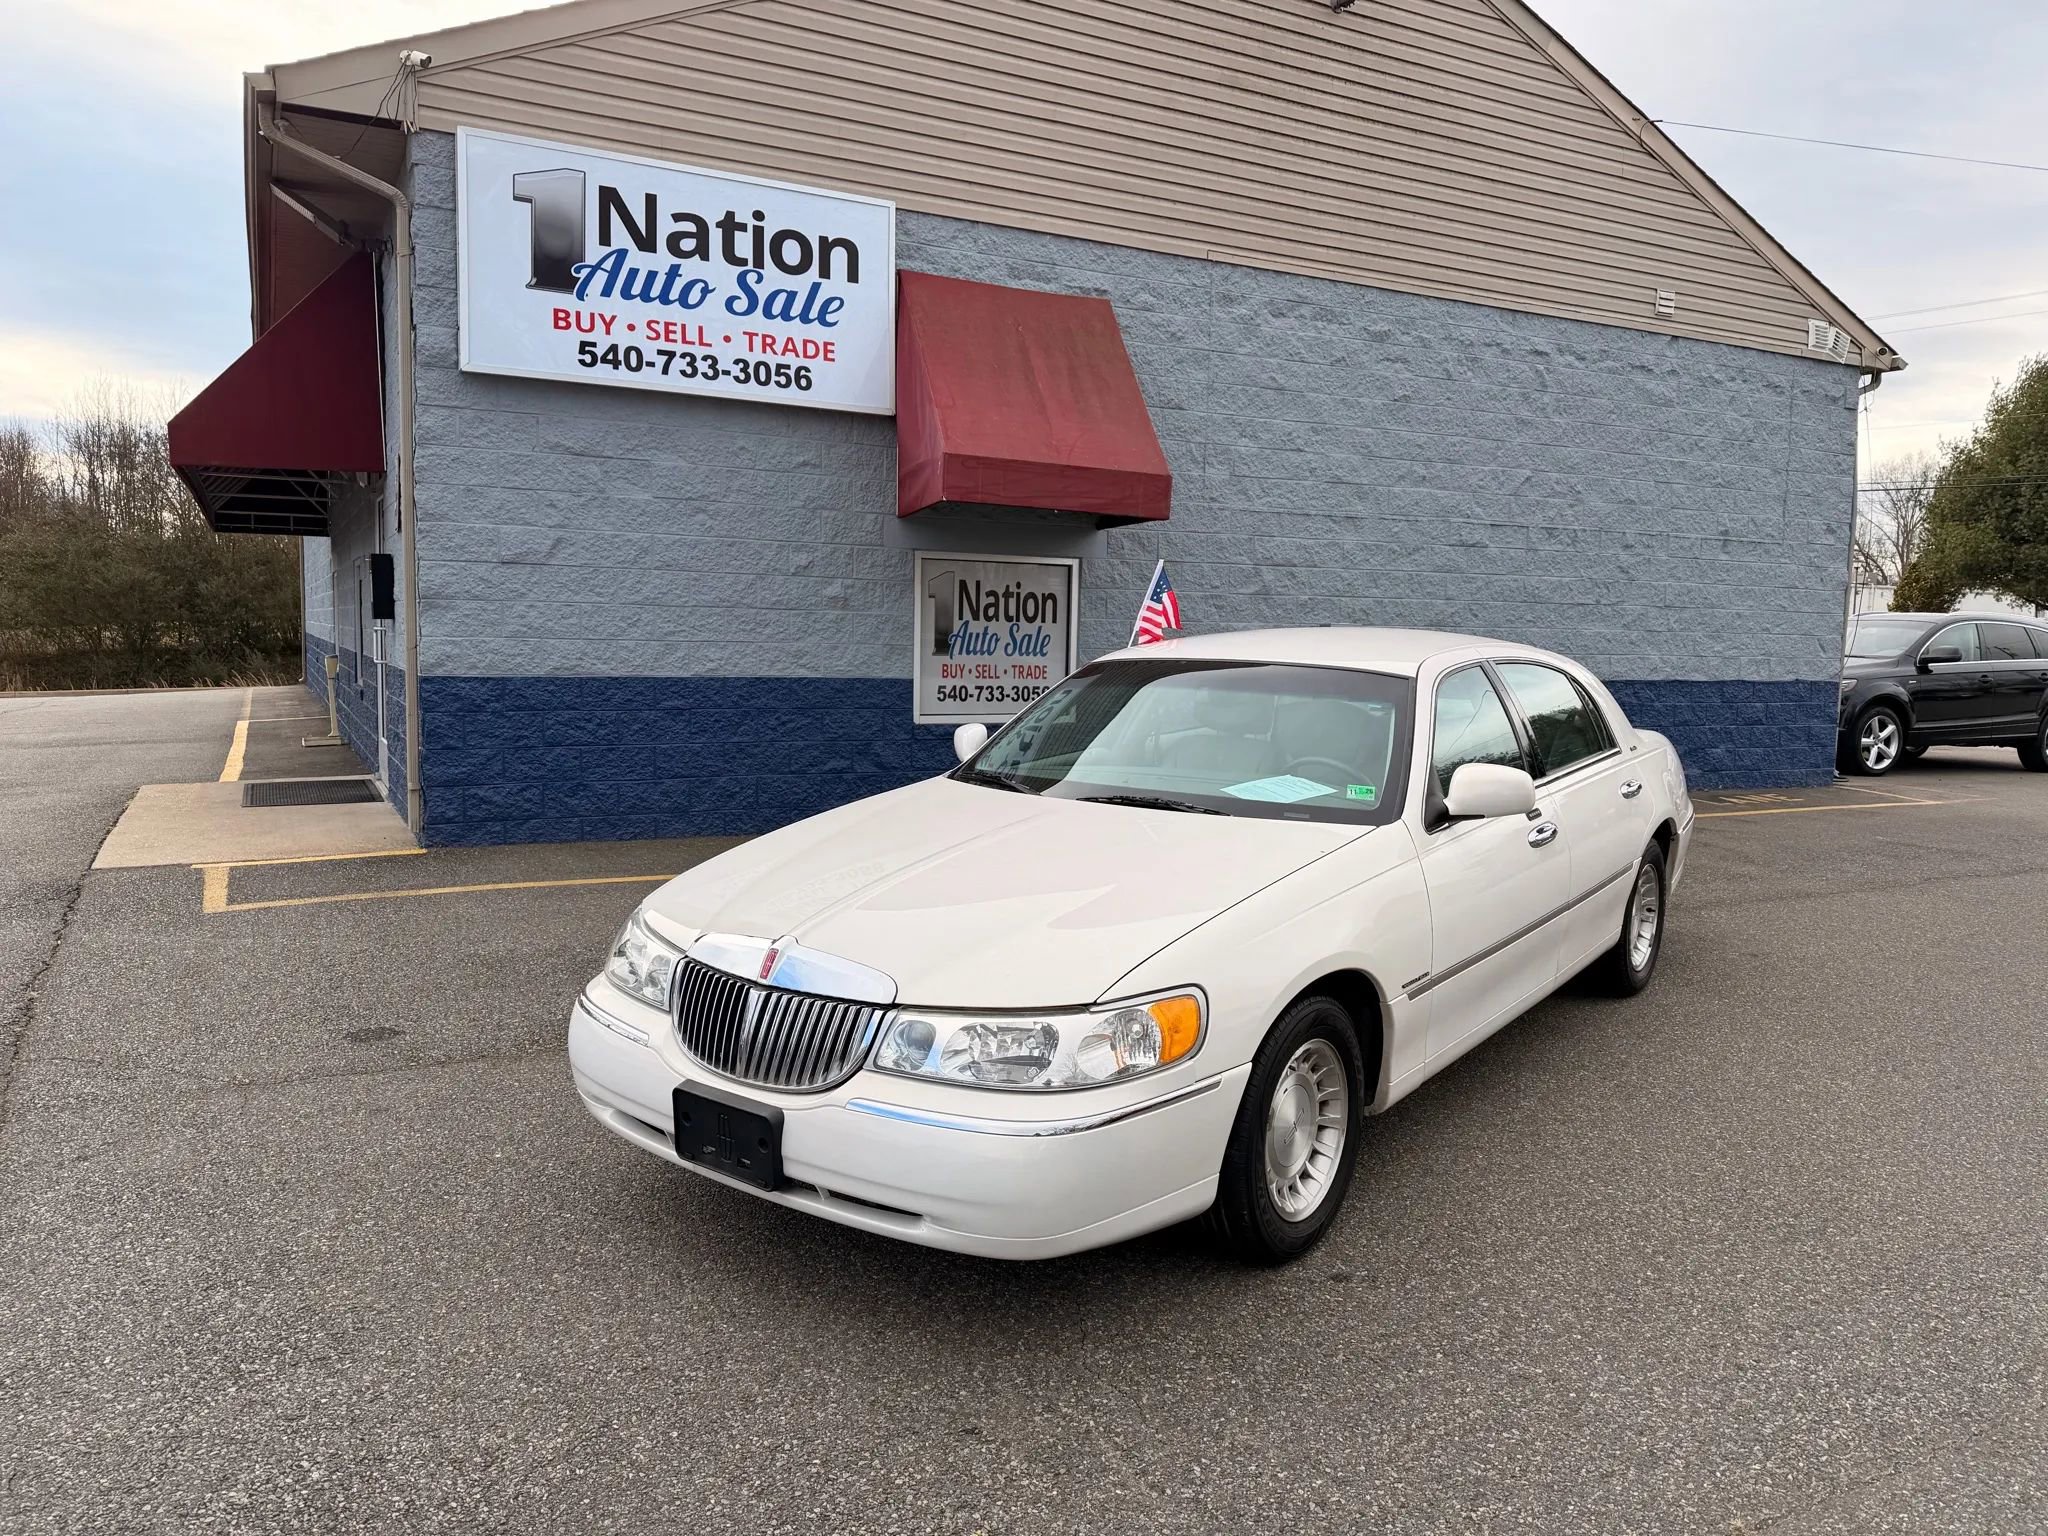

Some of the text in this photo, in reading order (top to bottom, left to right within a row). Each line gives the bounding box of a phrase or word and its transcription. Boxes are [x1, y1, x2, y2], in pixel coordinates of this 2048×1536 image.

[512, 168, 859, 294] 1 Nation
[574, 248, 845, 328] Auto Sale
[552, 308, 836, 362] BUY SELL TRADE
[577, 340, 813, 391] 540-733-3056
[928, 571, 1058, 657] 1 Nation
[948, 620, 1051, 660] Auto Sale
[941, 664, 1047, 680] BUY SELL TRADE
